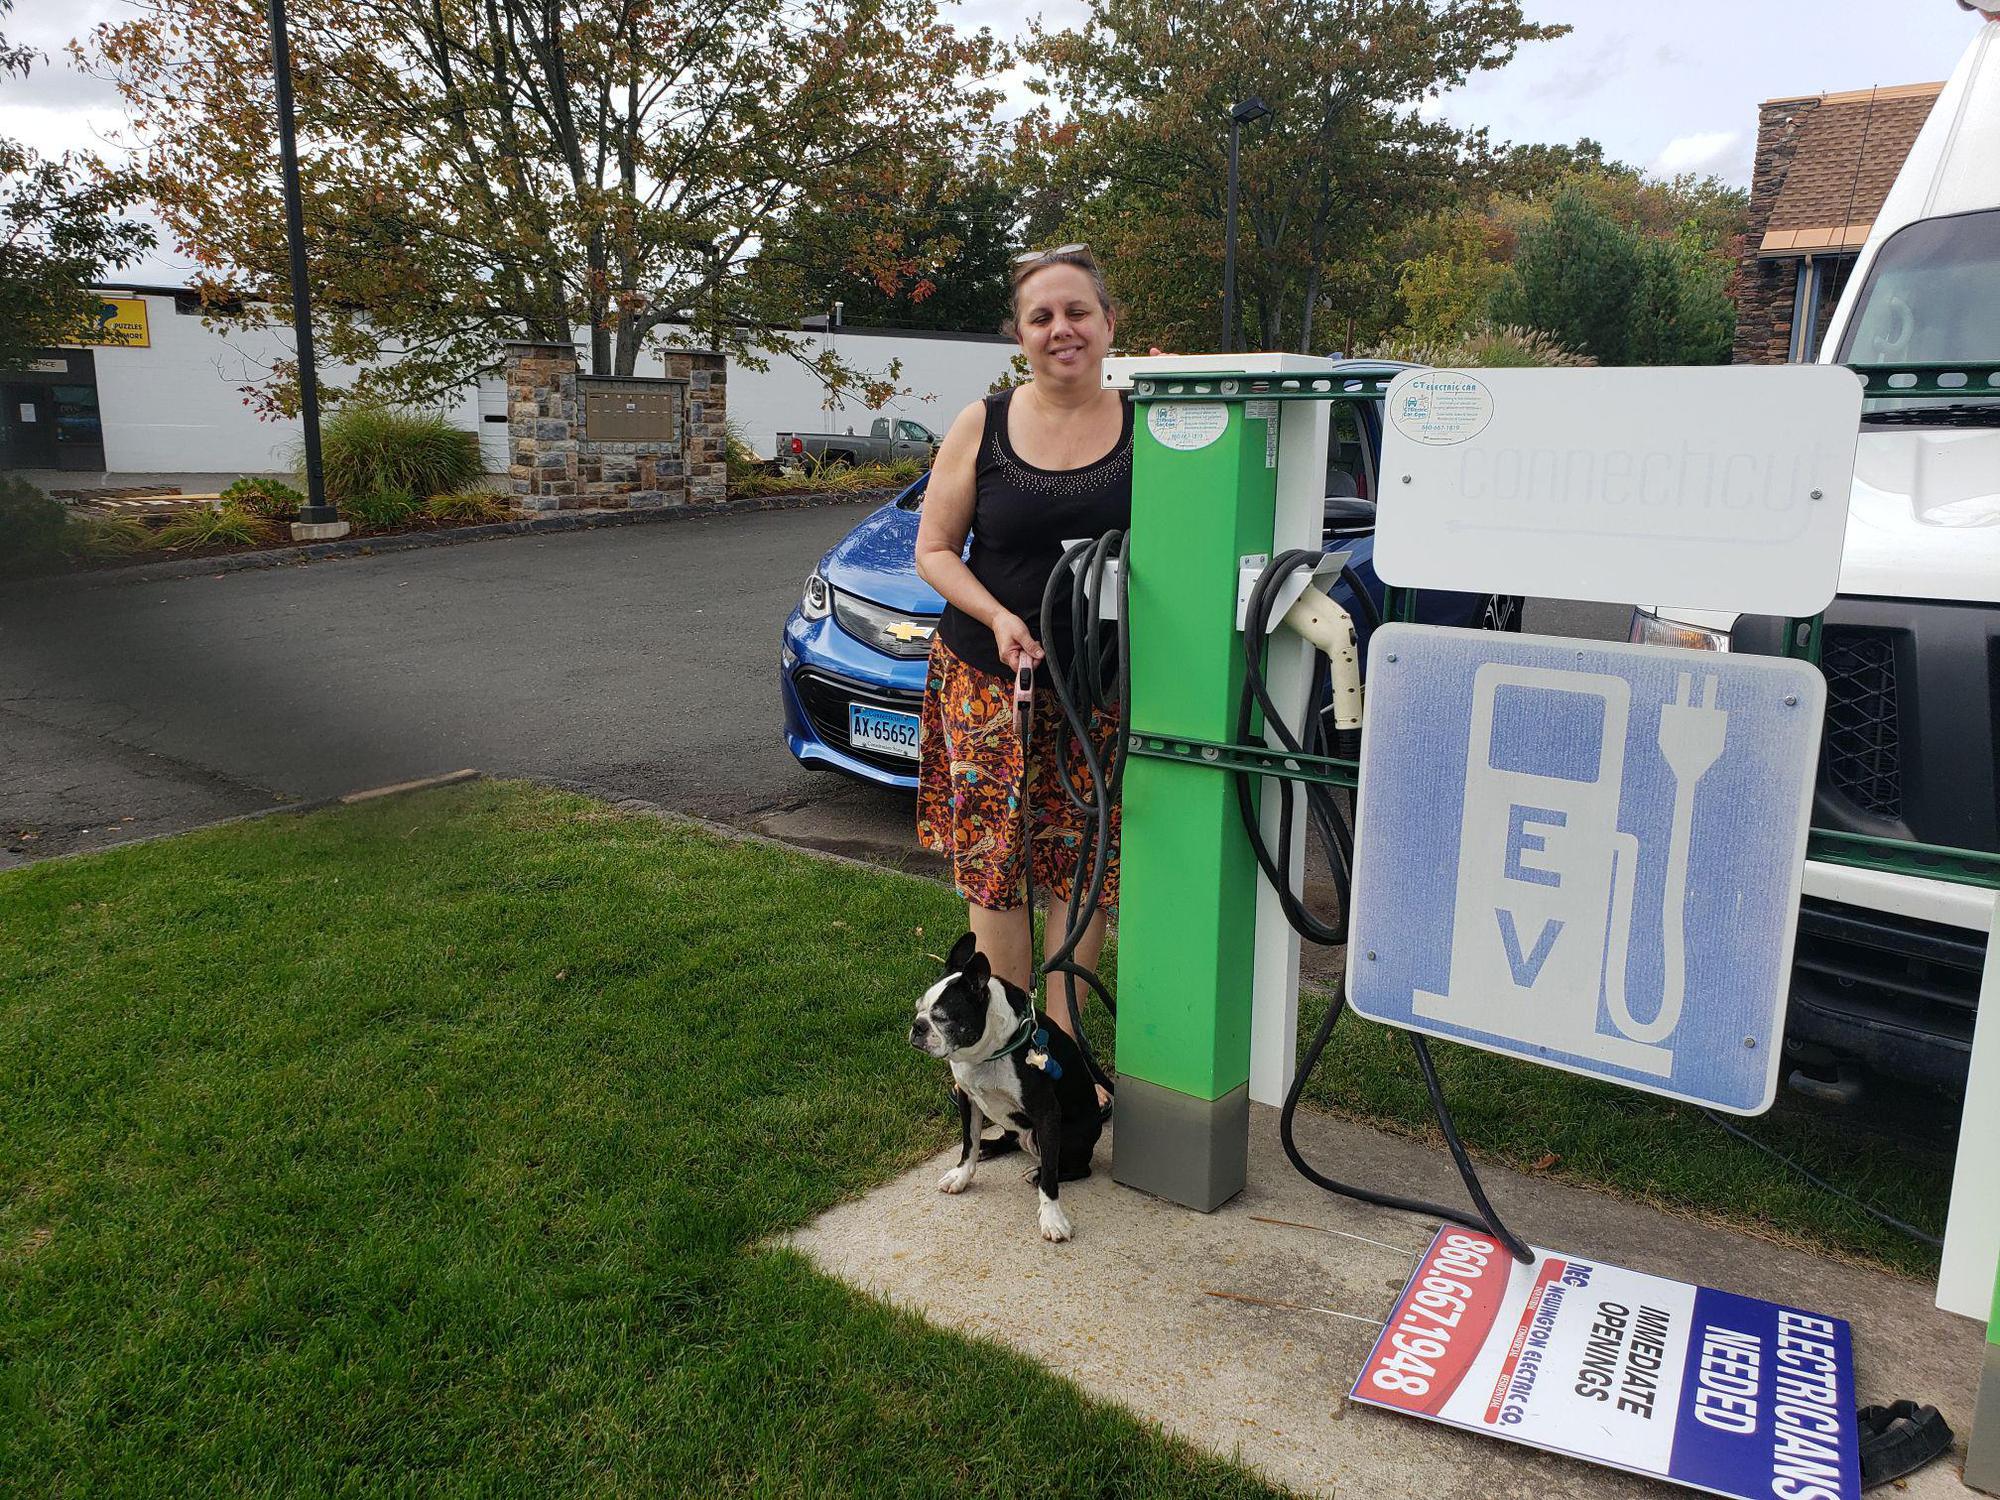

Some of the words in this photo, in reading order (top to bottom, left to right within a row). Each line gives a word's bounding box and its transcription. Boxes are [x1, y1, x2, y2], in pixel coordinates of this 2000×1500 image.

[114, 322, 143, 331] PUZZLES
[1426, 383, 1459, 392] ELECTRIC
[1461, 384, 1477, 392] CAR
[1372, 1234, 1495, 1397] 860.667.1948
[1527, 1284, 1567, 1350] NEWINGTON
[1508, 1350, 1543, 1404] ELECTRIC
[1574, 1301, 1630, 1402] OPENINGS
[1616, 1304, 1671, 1420] IMMEDIATE
[1693, 1324, 1762, 1435] NEEDED
[1489, 1373, 1511, 1409] RESIDENTIAL
[1499, 1405, 1525, 1427] CO.
[1771, 1309, 1841, 1500] ELECTRICIANS
